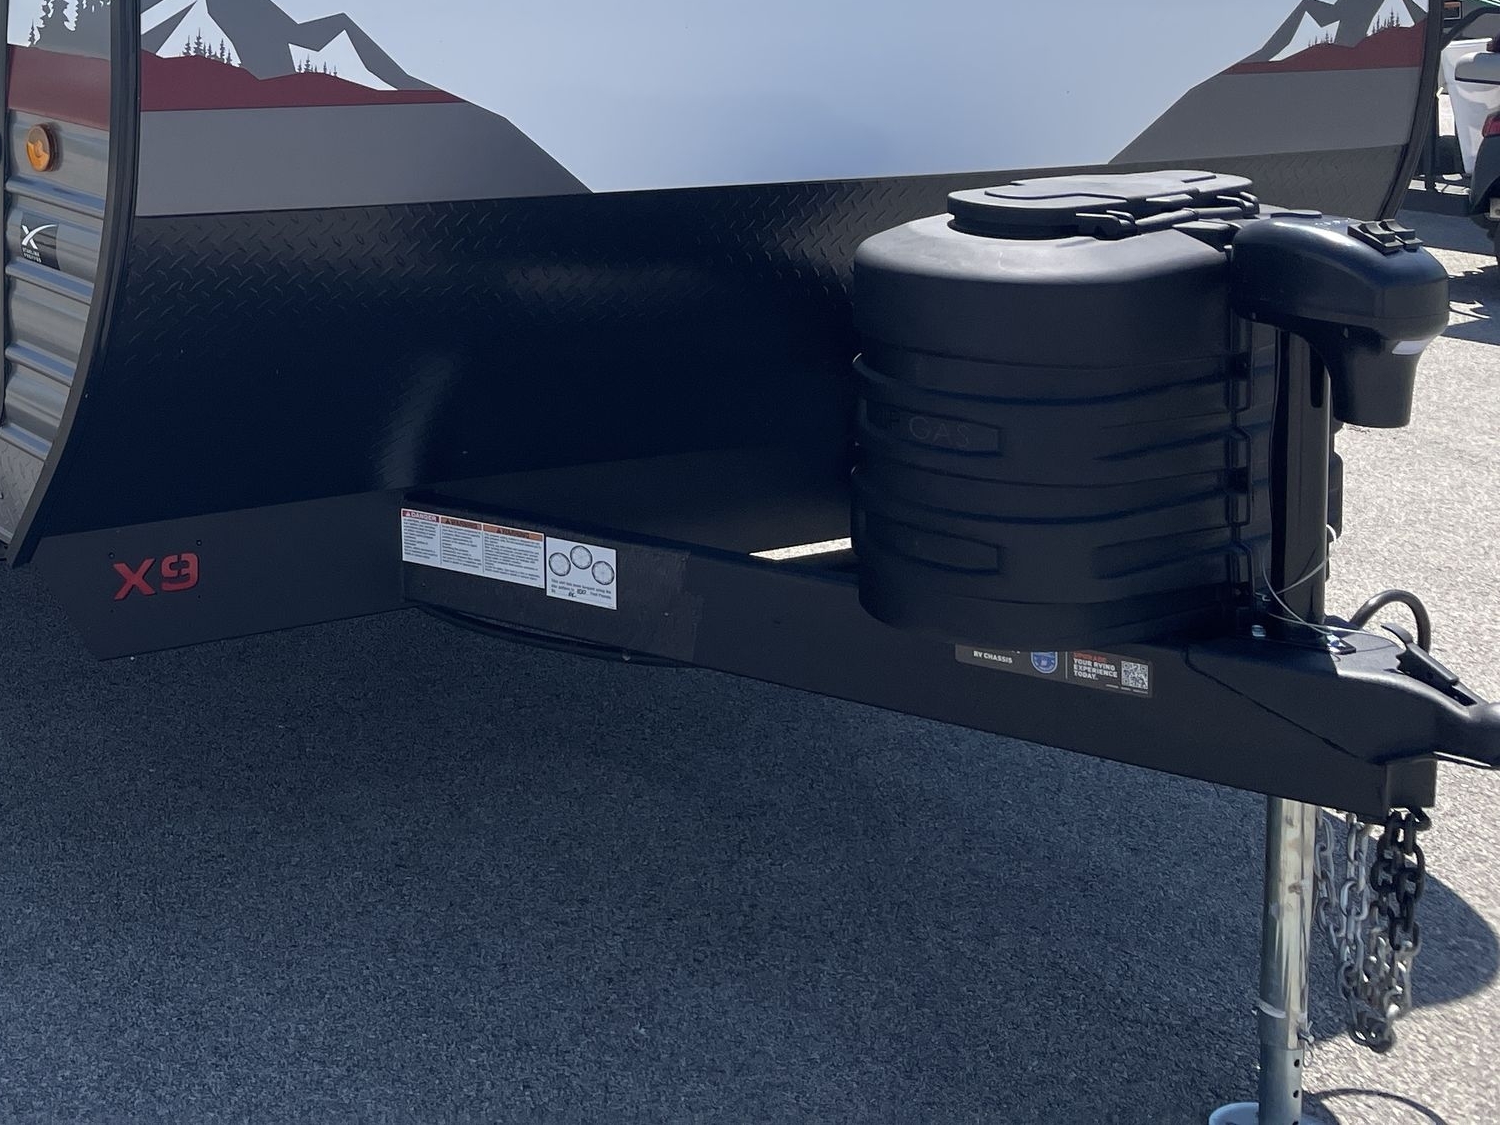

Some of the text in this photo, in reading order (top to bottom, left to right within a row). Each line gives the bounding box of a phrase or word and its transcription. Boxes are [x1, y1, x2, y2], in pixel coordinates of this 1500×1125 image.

[909, 416, 972, 449] GAS
[411, 512, 437, 522] DANGER
[113, 552, 200, 602] X9
[973, 650, 1013, 664] RV CHASSIS
[1073, 658, 1093, 667] YOUR
[1073, 664, 1118, 678] EXPERIENCE
